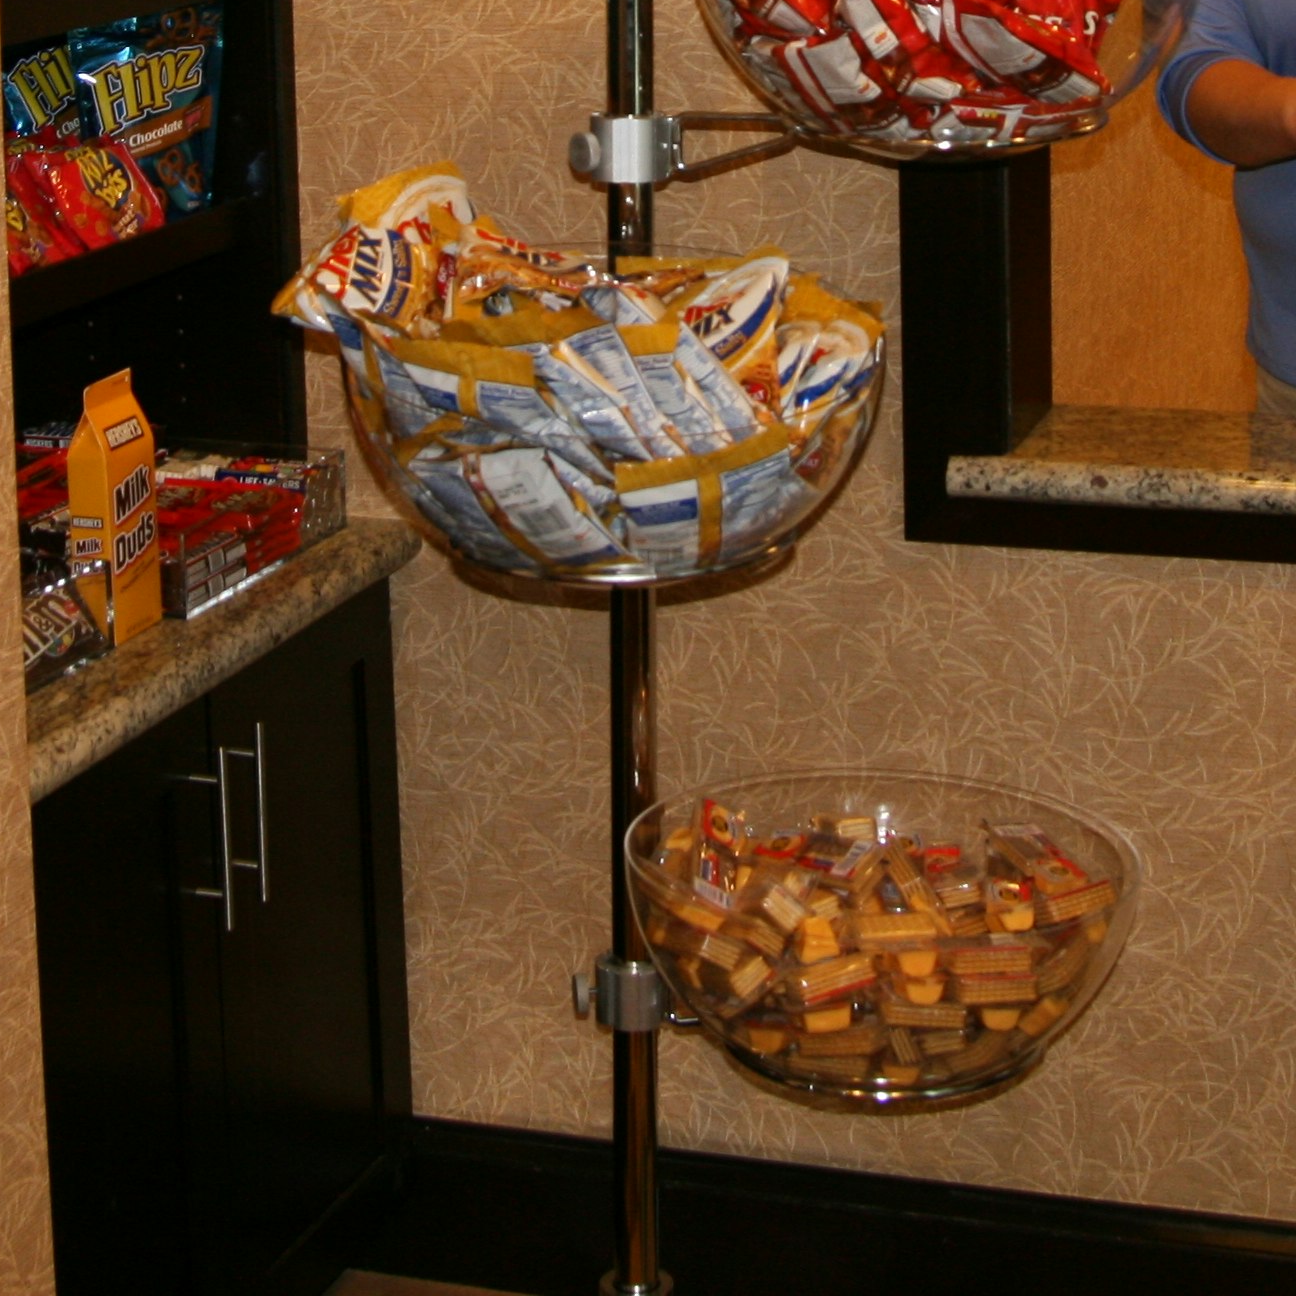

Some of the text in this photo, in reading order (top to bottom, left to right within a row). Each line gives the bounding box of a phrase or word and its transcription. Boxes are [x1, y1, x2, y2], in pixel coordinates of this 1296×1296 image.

[91, 47, 204, 134] Flipz
[129, 119, 183, 147] Chocolate
[115, 465, 150, 523] Milk
[76, 539, 102, 555] Milk
[115, 513, 154, 572] Duds
